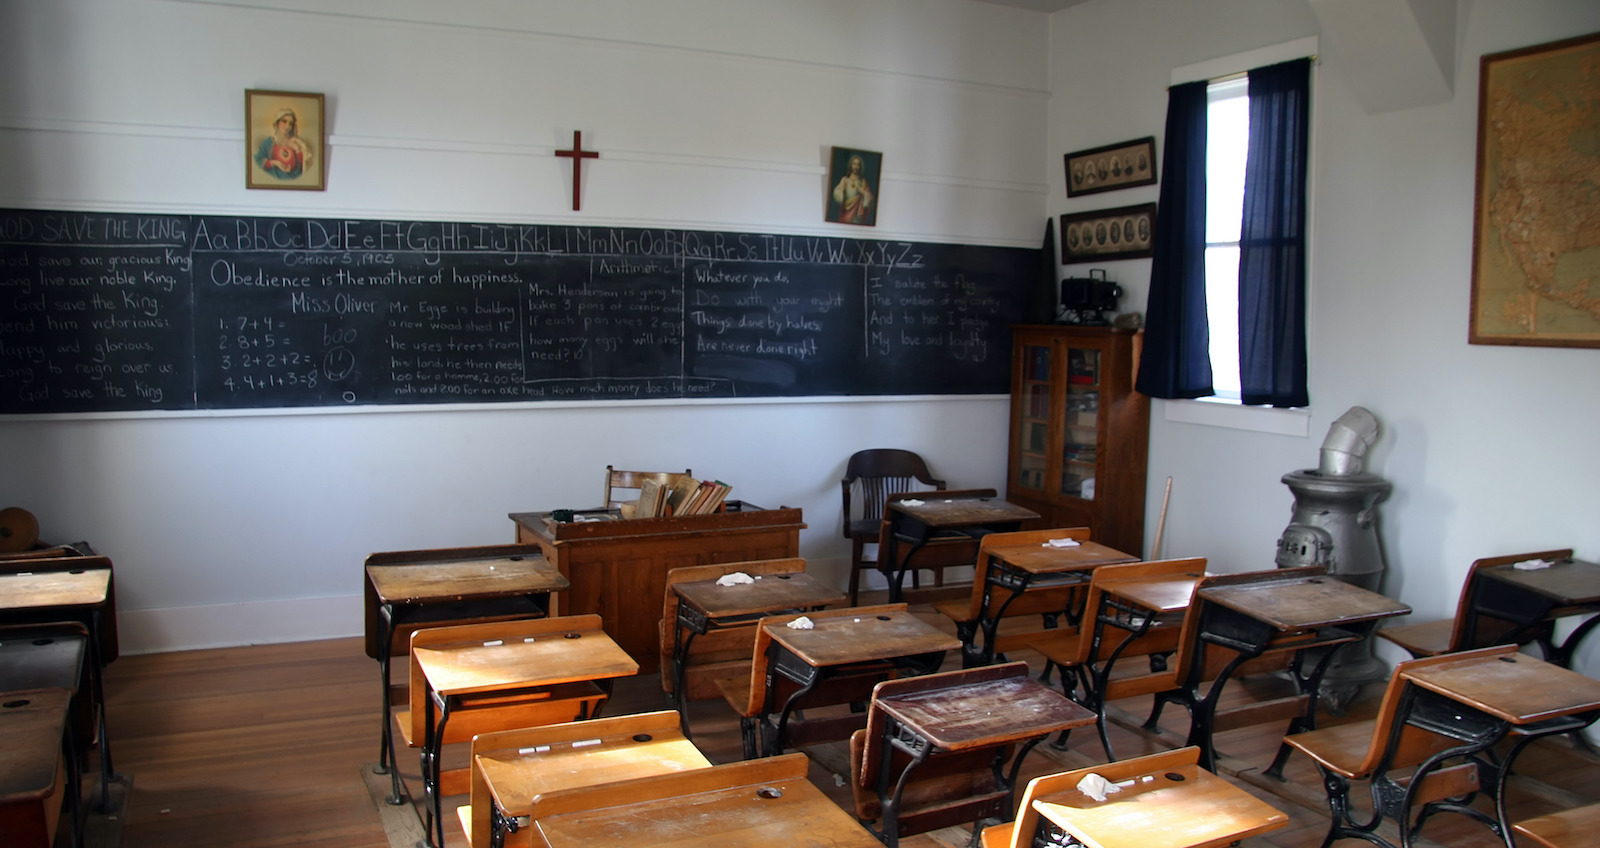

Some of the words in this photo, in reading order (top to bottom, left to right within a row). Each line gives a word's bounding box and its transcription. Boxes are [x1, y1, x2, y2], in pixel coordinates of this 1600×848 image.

[41, 216, 96, 241] SAVE
[101, 217, 132, 240] THE
[40, 257, 72, 267] save
[109, 254, 161, 273] gracious
[165, 248, 191, 272] King
[284, 252, 335, 267] October
[600, 258, 671, 275] Arithmetic
[41, 271, 65, 286] live
[69, 277, 93, 286] our
[100, 271, 136, 286] noble
[211, 259, 310, 287] Obedience
[322, 273, 332, 286] is
[336, 268, 364, 286] the
[369, 269, 425, 286] mother
[430, 268, 444, 284] of
[453, 267, 522, 290] happiness.
[695, 268, 748, 284] Whatever
[753, 273, 771, 289] you
[869, 277, 883, 288] I
[529, 282, 554, 297] Mrs.
[558, 282, 618, 299] Henderson
[640, 286, 666, 301] going
[868, 293, 893, 306] The
[14, 296, 46, 311] God
[55, 300, 87, 311] save
[92, 293, 117, 311] the
[292, 291, 330, 314] Miss
[335, 293, 376, 314] Oliver
[529, 300, 556, 311] bake
[563, 299, 571, 311] 3
[696, 289, 720, 306] Do
[735, 291, 763, 306] with
[773, 297, 800, 313] your
[389, 301, 409, 314] Mr
[457, 306, 468, 314] is
[475, 297, 515, 323] building
[870, 310, 894, 325] And
[903, 309, 915, 323] to
[922, 311, 940, 324] her
[47, 315, 78, 331] him
[389, 320, 397, 328] a
[401, 320, 423, 329] new
[545, 315, 574, 326] each
[584, 316, 608, 331] pan
[615, 318, 642, 326] uses
[651, 317, 660, 328] 2
[690, 311, 730, 335] Things
[738, 314, 765, 328] done
[767, 313, 782, 336] by
[447, 336, 484, 351] trees
[488, 338, 519, 349] from
[529, 332, 553, 345] how
[559, 337, 588, 349] many
[633, 333, 653, 345] will
[697, 333, 717, 352] Are
[721, 341, 751, 352] never
[756, 338, 786, 354] done
[787, 337, 818, 360] right
[870, 331, 891, 356] My
[901, 329, 921, 346] love
[926, 334, 943, 346] and
[446, 358, 460, 369] he
[464, 358, 492, 368] then
[531, 350, 570, 363] need?
[49, 360, 63, 374] to
[75, 362, 113, 380] reign
[121, 363, 152, 373] over
[416, 371, 432, 381] for
[64, 388, 94, 399] save
[104, 381, 127, 398] the
[134, 380, 163, 403] King
[419, 383, 437, 394] and
[463, 384, 479, 395] for
[552, 386, 574, 396] How
[579, 383, 604, 394] much
[608, 386, 639, 397] money
[646, 381, 669, 394] does
[687, 382, 716, 394] need?
